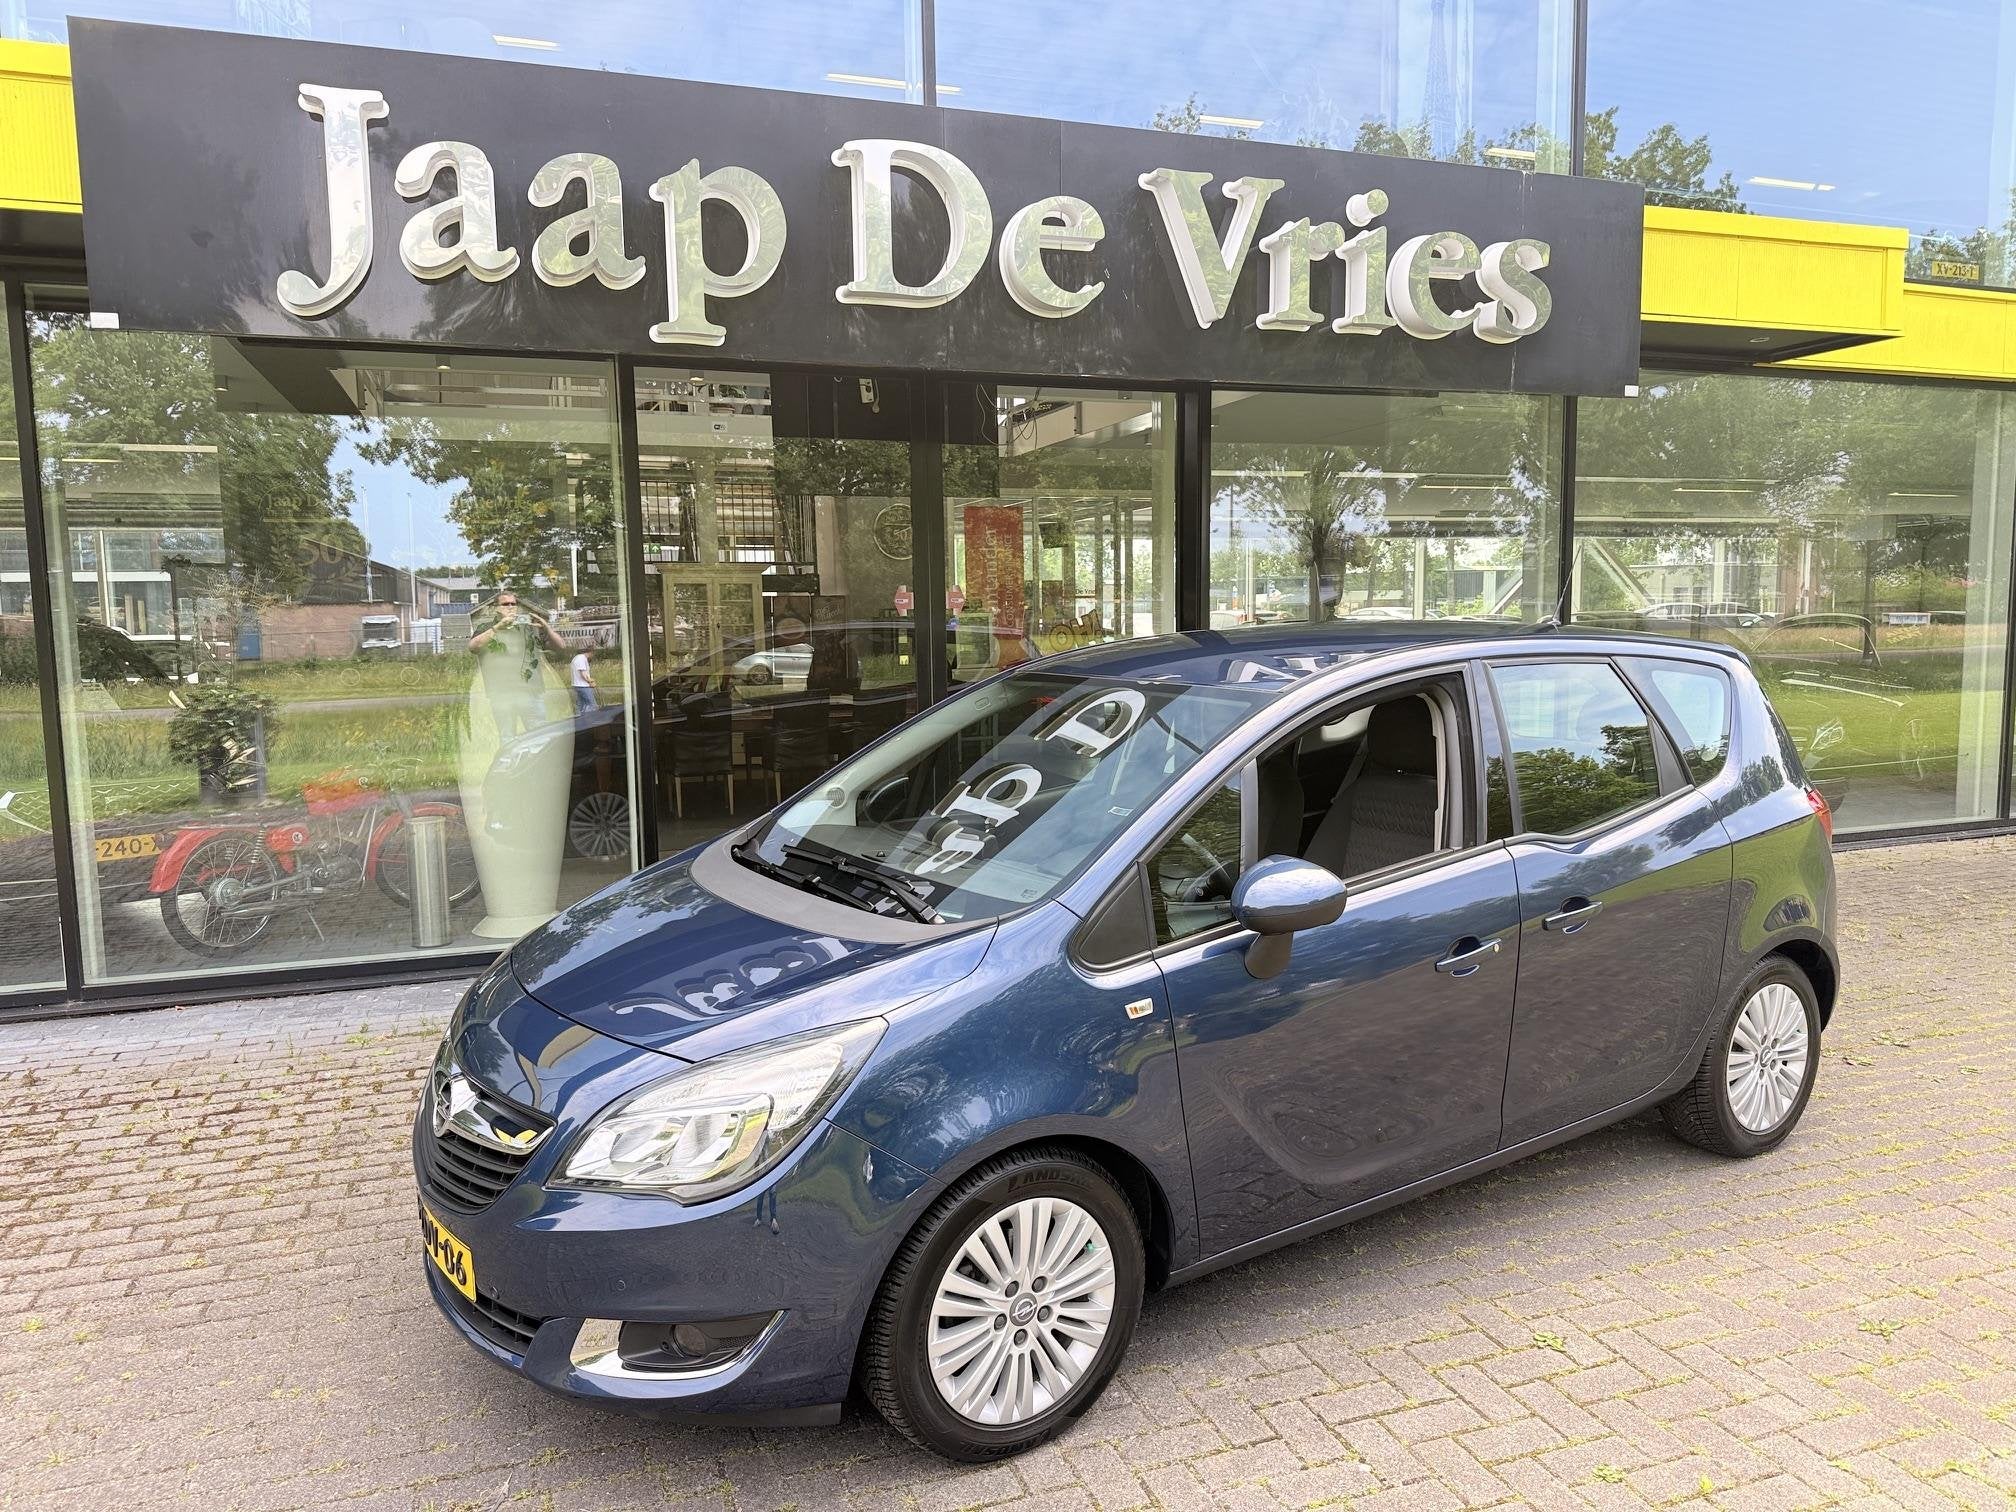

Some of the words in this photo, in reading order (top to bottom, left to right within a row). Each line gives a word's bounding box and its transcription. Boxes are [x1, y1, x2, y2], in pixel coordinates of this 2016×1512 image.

[276, 82, 788, 347] Jaap
[831, 138, 1106, 319] De
[1138, 167, 1553, 345] Vries
[980, 525, 999, 627] antander
